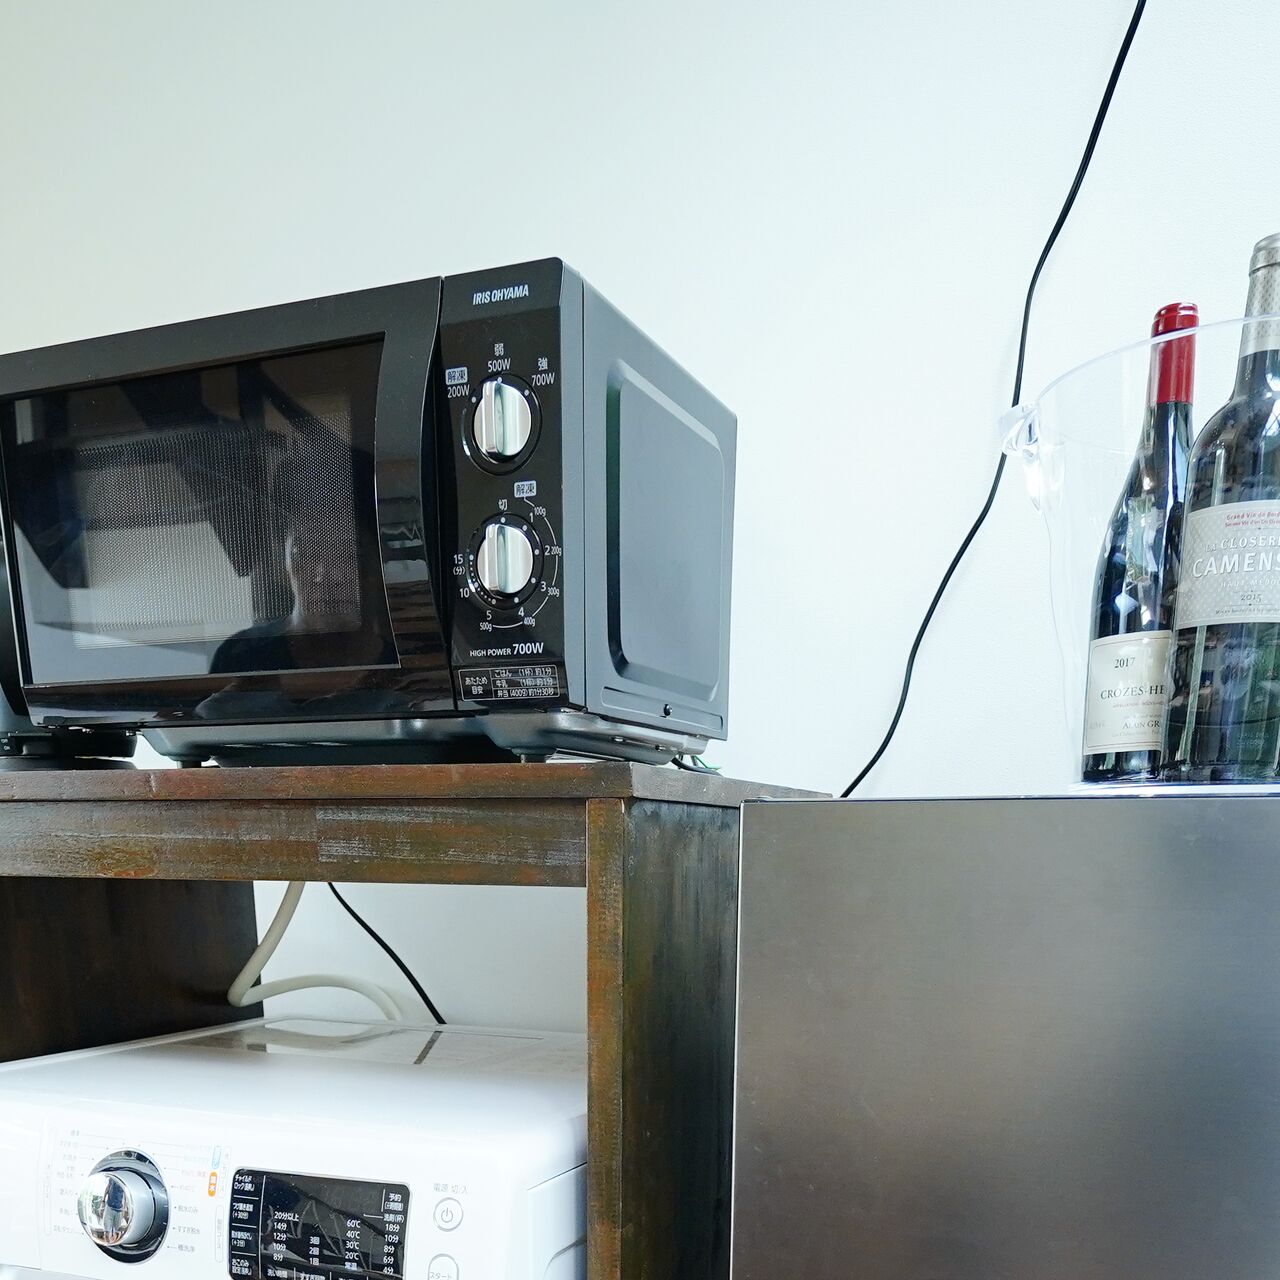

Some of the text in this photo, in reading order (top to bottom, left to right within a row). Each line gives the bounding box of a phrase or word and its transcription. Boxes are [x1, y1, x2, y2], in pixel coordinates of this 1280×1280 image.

[472, 284, 529, 306] IRIS OHYAMA
[494, 343, 504, 356] 弱
[487, 358, 511, 373] 500W
[537, 357, 549, 371] 強
[447, 369, 467, 384] 解凍
[531, 372, 555, 387] 700W
[447, 384, 470, 399] 200W
[515, 483, 535, 496] 解凍
[498, 499, 508, 511] 切
[529, 506, 547, 523] 1 100g
[544, 545, 562, 557] 2 200g
[453, 554, 464, 565] 15
[452, 565, 466, 576] (分)
[459, 588, 470, 598] 10
[540, 581, 560, 598] 3 300g
[486, 610, 492, 620] 5
[518, 607, 536, 628] 4 400g
[479, 622, 493, 632] 500g
[470, 642, 544, 657] HIGH POWER 700W
[1114, 656, 1136, 669] 2017
[465, 676, 488, 686] あたため
[472, 686, 484, 695] 目安
[1100, 684, 1166, 700] CROZES-HE
[1147, 719, 1160, 728] GR
[274, 1211, 300, 1222] 20分以上
[273, 1222, 288, 1231] 14分
[346, 1219, 361, 1229] 60℃
[385, 1223, 400, 1233] 18分
[273, 1232, 287, 1241] 12分
[346, 1230, 360, 1239] 40℃
[384, 1234, 399, 1243] 10分
[309, 1236, 320, 1245] 3回
[345, 1240, 360, 1250] 30℃
[272, 1242, 287, 1251] 10分
[309, 1246, 320, 1256] 2回
[383, 1245, 395, 1254] 8分
[272, 1252, 284, 1262] 8分
[345, 1251, 360, 1260] 20℃
[382, 1255, 395, 1265] 6分
[309, 1257, 320, 1266] 1回
[382, 1266, 394, 1275] 4分
